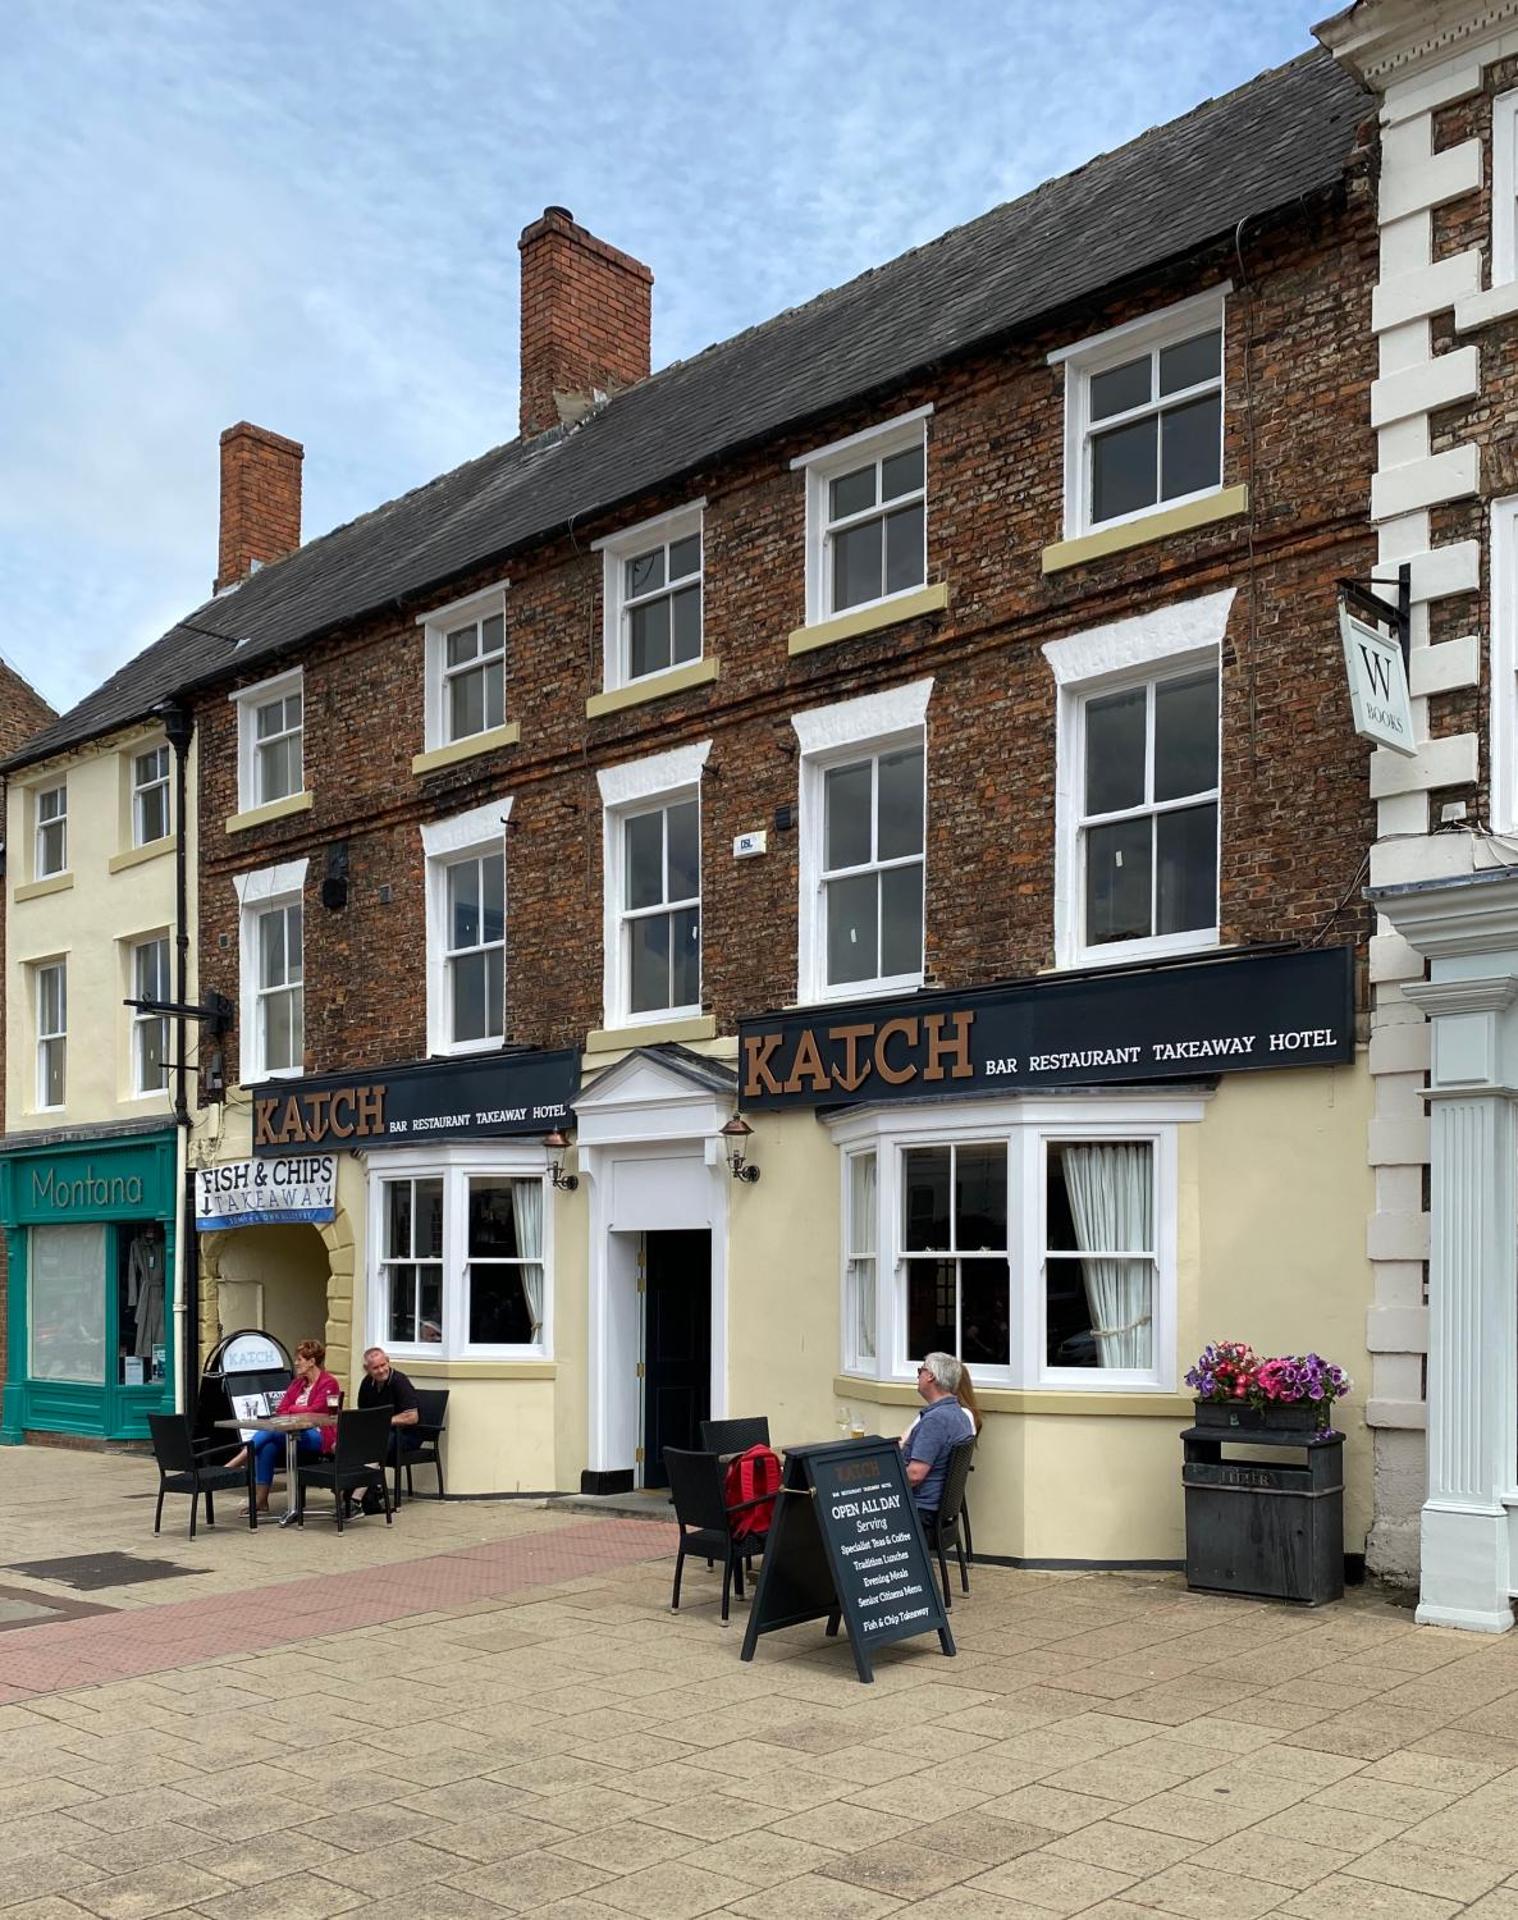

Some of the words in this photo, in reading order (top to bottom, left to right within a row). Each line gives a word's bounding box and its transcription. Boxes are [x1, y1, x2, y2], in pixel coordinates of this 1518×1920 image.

[1358, 643, 1392, 701] W
[1366, 702, 1403, 734] BOOKS
[743, 1011, 974, 1097] KATCH
[986, 1057, 1018, 1077] BAR
[1028, 1046, 1142, 1073] RESTAURANT
[1152, 1035, 1256, 1061] TAKEAWAY
[1269, 1029, 1337, 1052] HOTEL
[255, 1085, 385, 1145] KATCH
[389, 1119, 407, 1134] BAR
[412, 1113, 471, 1131] RESTAURANT
[476, 1108, 527, 1124] TAKEAWAY
[533, 1103, 567, 1119] HOTEL
[32, 1164, 144, 1209] Montana
[201, 1163, 251, 1194] FISH
[254, 1161, 268, 1187] &
[273, 1156, 334, 1186] CHIPS
[215, 1186, 327, 1213] TAKEAWAY
[228, 1350, 275, 1366] KATCH
[831, 1502, 860, 1520] OPEN
[861, 1498, 881, 1514] ALL
[880, 1494, 901, 1510] DAY
[856, 1518, 888, 1533] Serving
[840, 1541, 871, 1556] Specialist
[871, 1539, 886, 1549] Teas
[885, 1536, 892, 1545] &
[891, 1532, 911, 1544] Coffee
[853, 1557, 884, 1571] Tradition
[882, 1551, 909, 1564] Lunches
[863, 1574, 890, 1587] Evening
[889, 1568, 909, 1581] Meals
[858, 1595, 880, 1608] Senior
[903, 1584, 923, 1597] Menu
[863, 1619, 879, 1632] Fish
[878, 1618, 885, 1628] &
[884, 1614, 899, 1625] Chip
[898, 1607, 929, 1622] Takeaway
